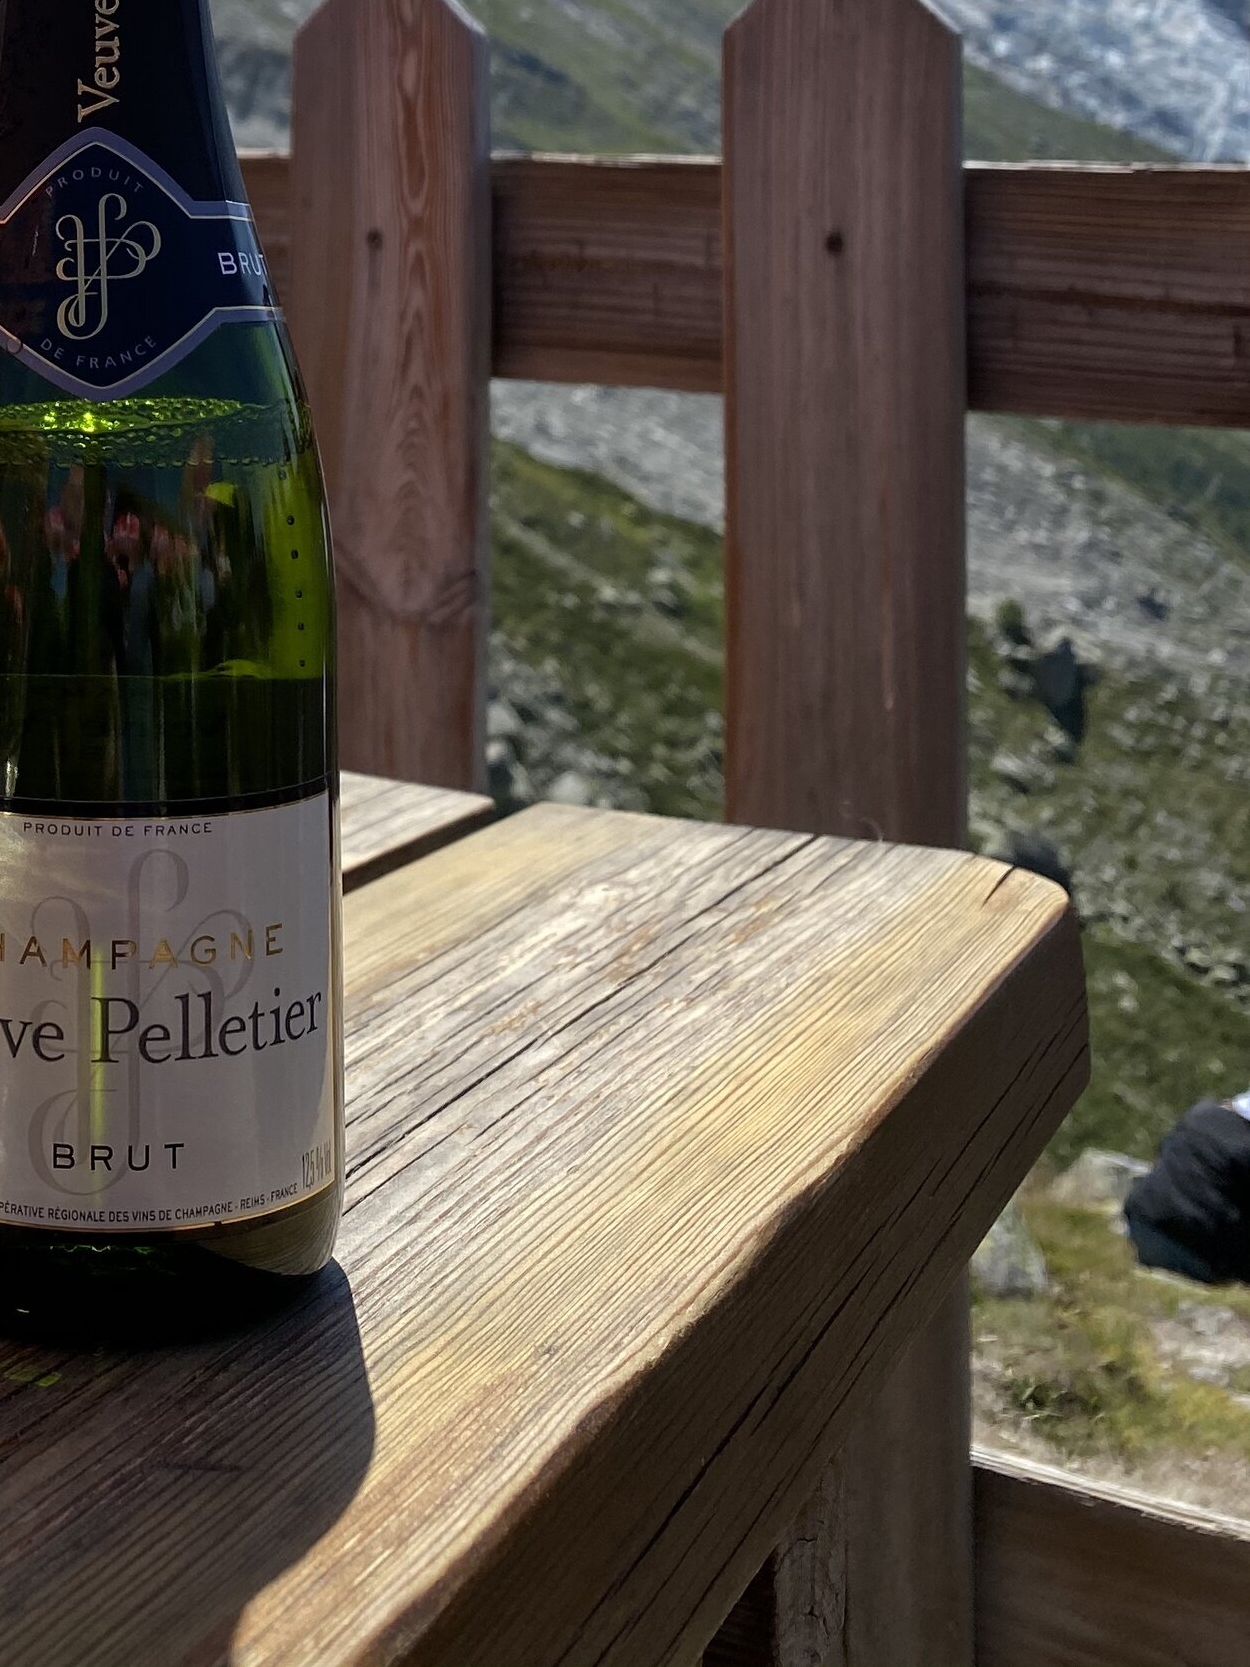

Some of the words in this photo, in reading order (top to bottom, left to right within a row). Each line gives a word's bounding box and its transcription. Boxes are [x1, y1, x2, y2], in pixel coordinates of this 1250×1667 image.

[45, 166, 144, 198] PRODUIT
[39, 337, 65, 361] DE
[76, 334, 157, 370] FRANCE
[22, 822, 103, 837] PRODUIT
[111, 825, 136, 837] DE
[142, 822, 213, 835] FRANCE
[90, 986, 323, 1064] Pelletier
[52, 1142, 185, 1171] BRUT
[47, 1206, 105, 1223] RÉGIONALE
[108, 1211, 130, 1223] DES
[132, 1211, 156, 1222] VINS
[158, 1209, 172, 1221] DE
[174, 1201, 233, 1220] CHAMPAGNE
[240, 1194, 265, 1211] REIMS
[270, 1182, 298, 1202] FRANCE
